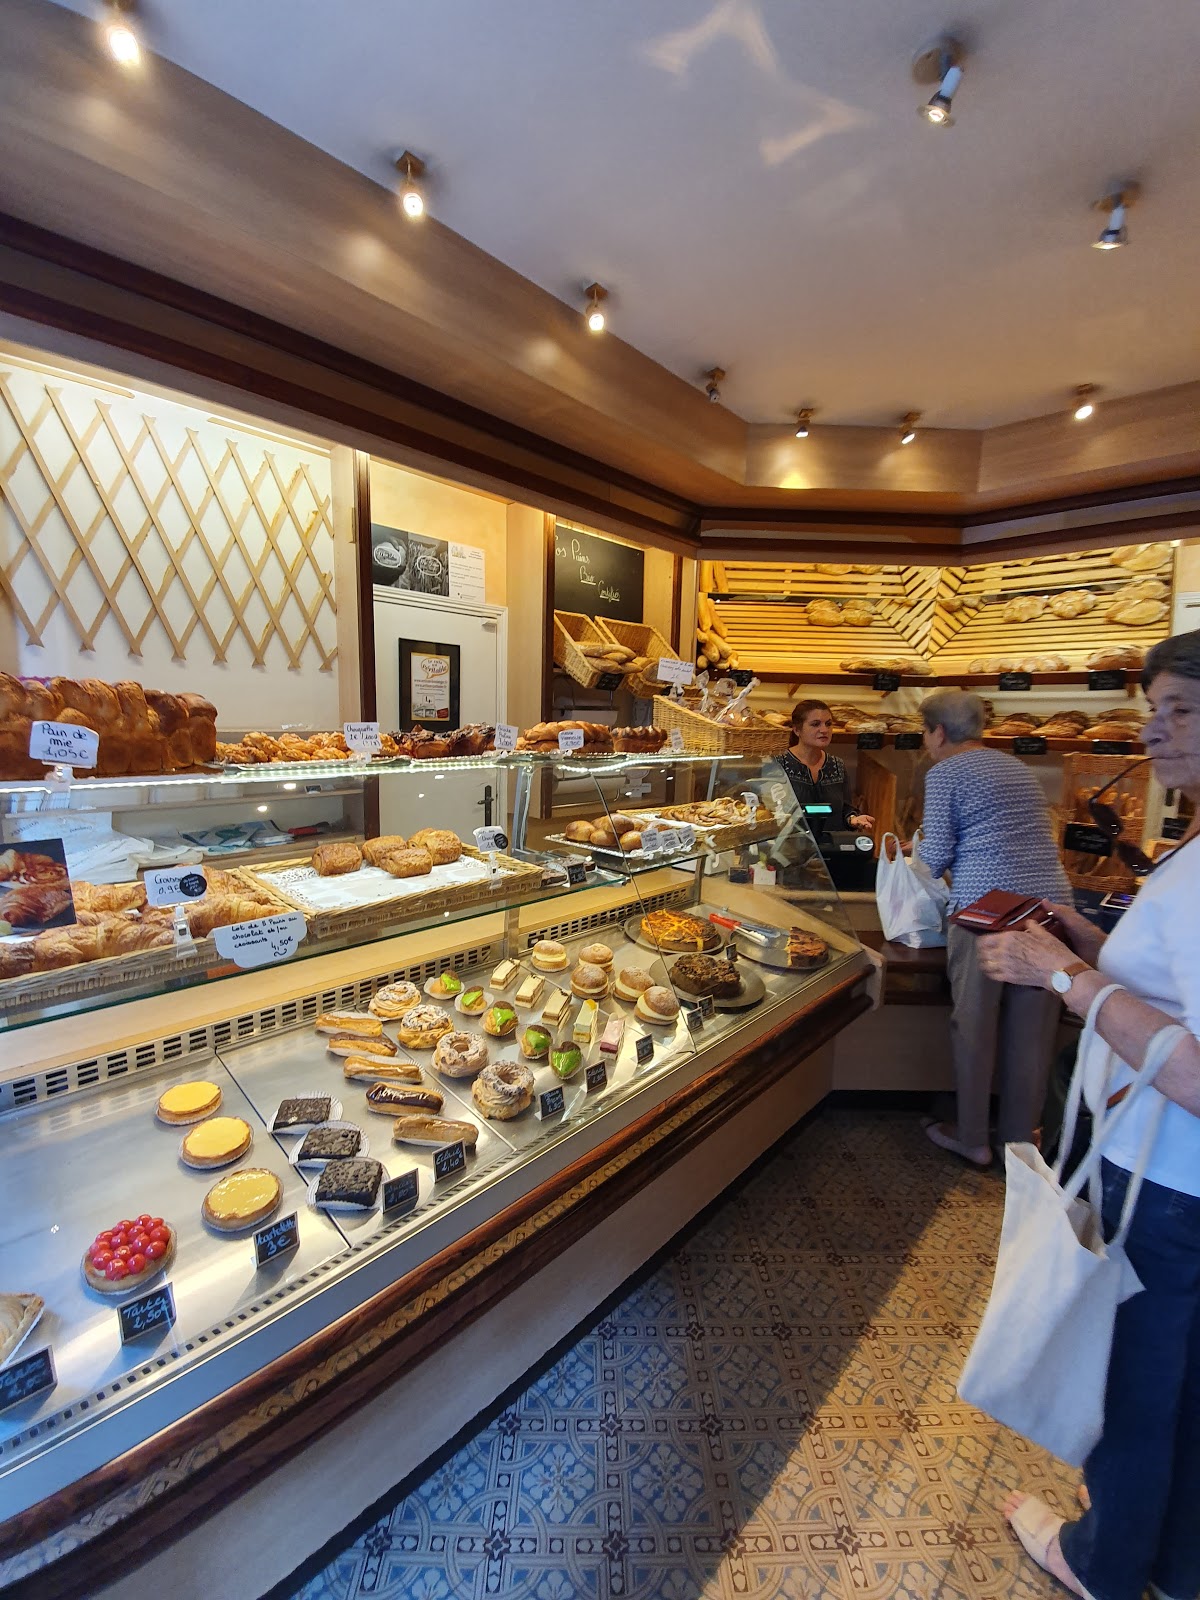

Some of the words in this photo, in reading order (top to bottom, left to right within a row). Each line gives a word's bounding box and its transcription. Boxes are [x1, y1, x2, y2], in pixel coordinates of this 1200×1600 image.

[555, 535, 567, 558] os
[42, 722, 67, 737] Pain
[72, 729, 87, 741] de
[49, 737, 73, 748] mie
[231, 924, 246, 932] Lot
[231, 929, 264, 941] chocolat
